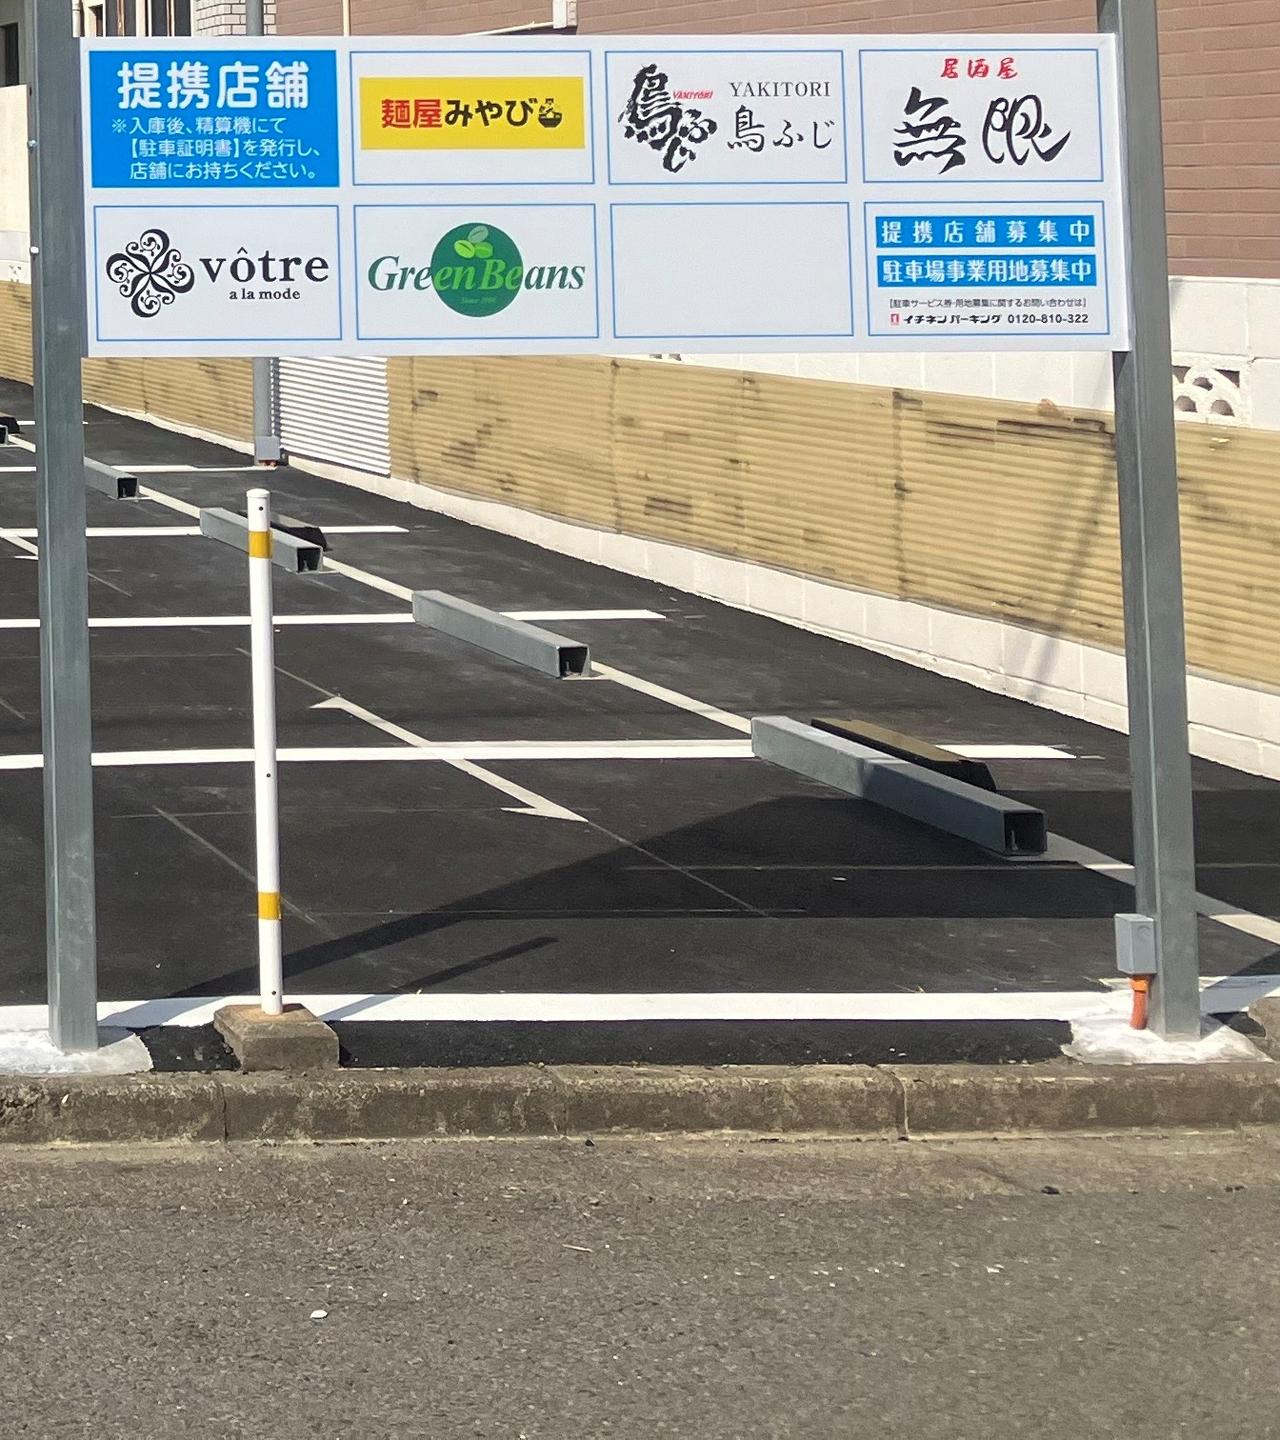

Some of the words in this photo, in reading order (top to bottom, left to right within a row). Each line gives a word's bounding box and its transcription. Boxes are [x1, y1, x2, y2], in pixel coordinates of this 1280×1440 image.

[117, 60, 309, 110] 提携店舗
[729, 81, 831, 98] YAKITORI
[111, 116, 287, 135] ※入庫後、精算機にて
[381, 97, 538, 129] 麺屋みやび
[727, 105, 835, 152] 鳥ふじ
[129, 161, 316, 180] 店舗にお持ちください。
[881, 219, 1090, 244] 提携店舗募集中
[199, 246, 329, 282] vôtre
[882, 258, 1091, 283] 駐車場事業用地募集中
[229, 291, 237, 300] a
[241, 288, 255, 300] la
[258, 288, 301, 300] mode
[1007, 313, 1089, 324] 0120-810-322
